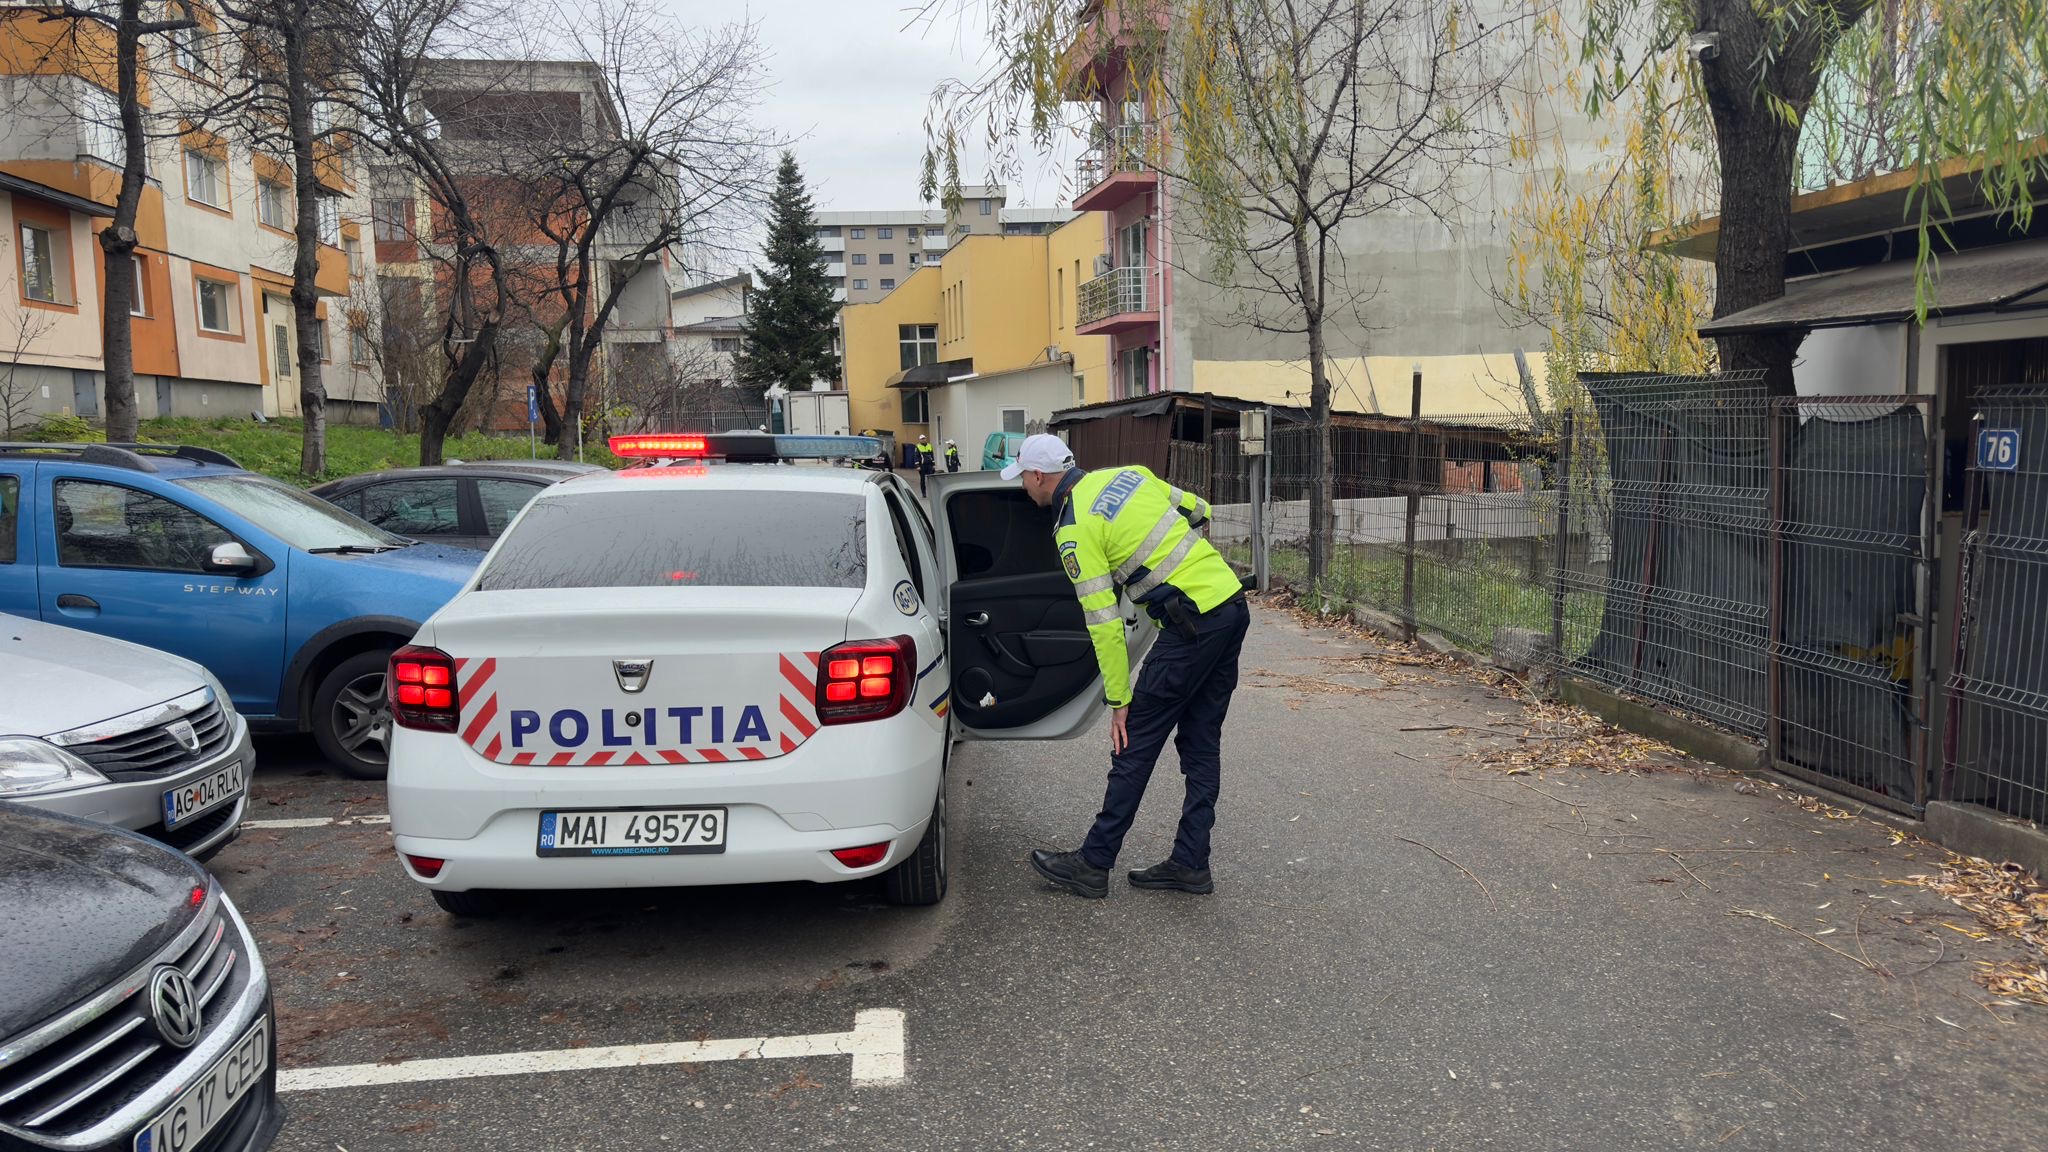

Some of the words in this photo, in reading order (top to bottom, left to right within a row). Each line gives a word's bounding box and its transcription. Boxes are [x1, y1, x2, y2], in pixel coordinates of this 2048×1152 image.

[530, 388, 536, 410] P
[1987, 436, 2011, 463] 76
[1095, 471, 1142, 516] POLITIA
[183, 584, 279, 596] STEPWAY
[510, 705, 772, 748] POLITIA
[176, 788, 194, 817] AG
[199, 778, 215, 806] 04
[217, 765, 240, 799] RLK
[540, 834, 555, 847] RO
[560, 816, 607, 845] MAI
[624, 813, 718, 844] 49579
[157, 1106, 187, 1152] AG
[197, 1072, 217, 1130] 17
[225, 1027, 264, 1100] CED
